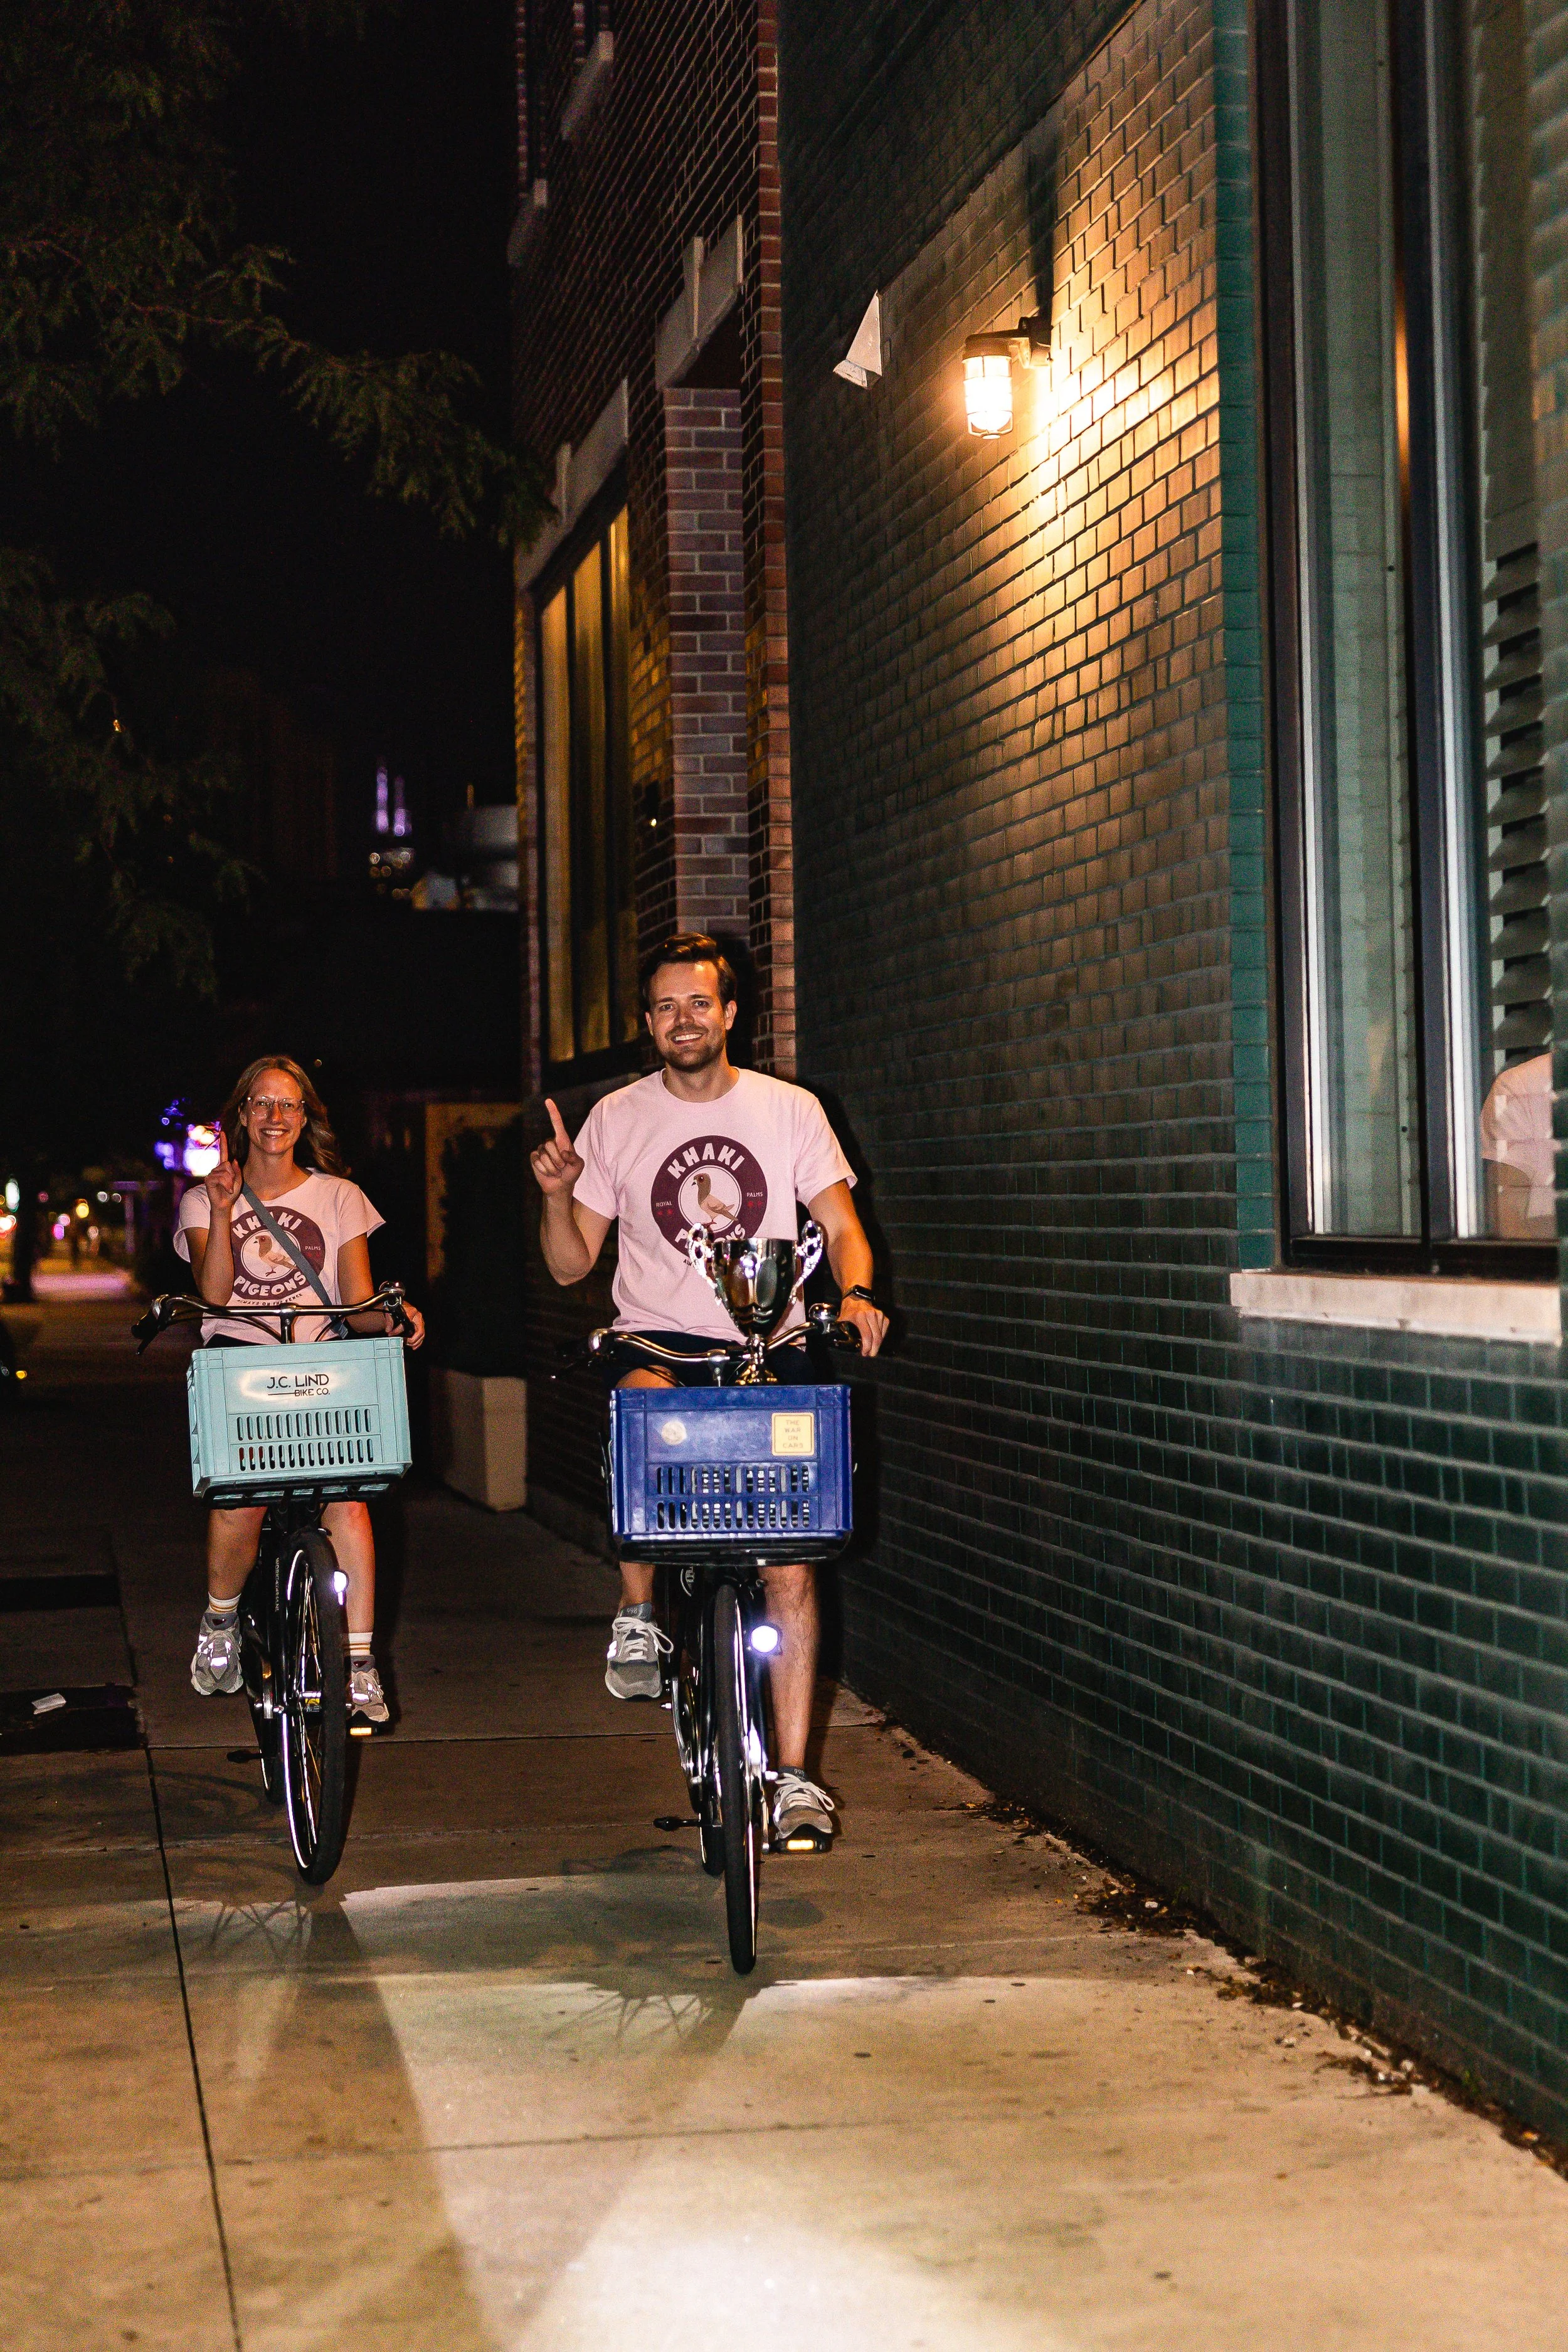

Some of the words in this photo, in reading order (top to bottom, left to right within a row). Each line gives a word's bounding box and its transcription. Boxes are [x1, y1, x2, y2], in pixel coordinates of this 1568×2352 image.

[667, 1143, 745, 1179] KHAKI
[232, 1211, 302, 1239] KHKI
[233, 1271, 306, 1296] PIGEONS
[285, 1293, 303, 1303] FENCE
[267, 1376, 291, 1389] J.C.
[295, 1374, 329, 1387] LIND
[295, 1389, 314, 1397] BIKE
[316, 1387, 331, 1396] CO.
